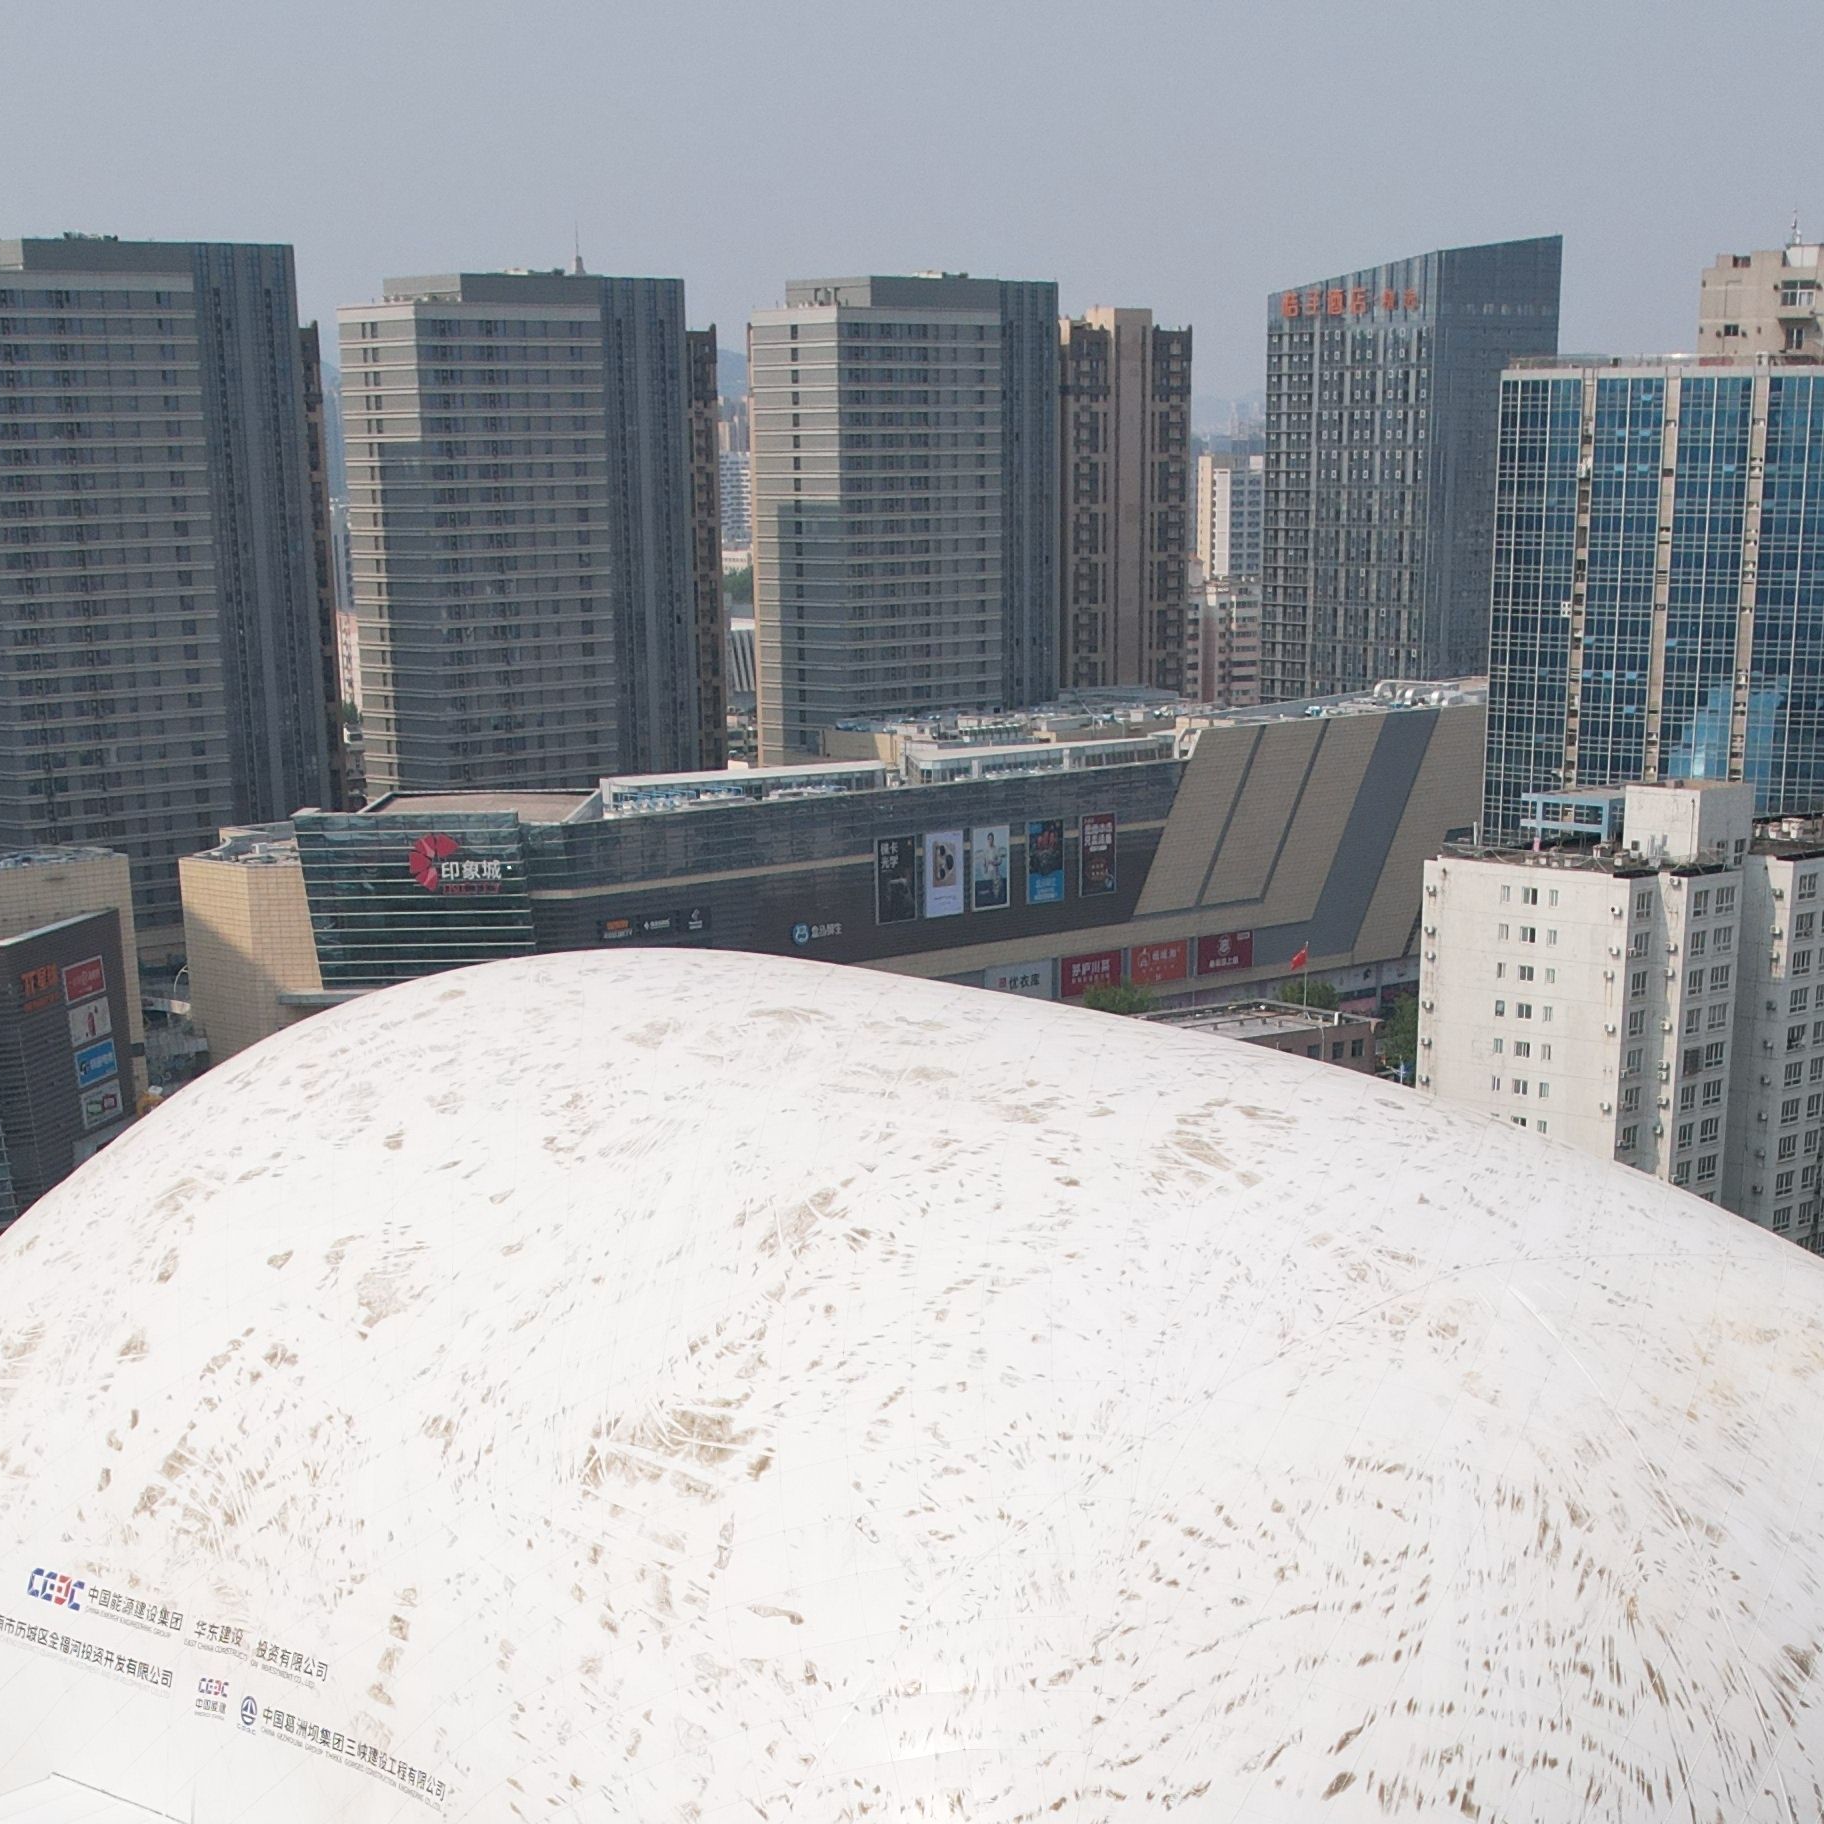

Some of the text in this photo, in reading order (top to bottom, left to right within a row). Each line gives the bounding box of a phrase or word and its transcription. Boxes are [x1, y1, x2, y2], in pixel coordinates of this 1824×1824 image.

[441, 859, 502, 880] 印象城
[1008, 973, 1040, 990] 优衣库
[87, 1584, 329, 1683] 中国能源建设集团 华东建设 投资有限公司
[262, 1706, 447, 1802] 中国葛洲坝集团三峡建设工程有限公司
